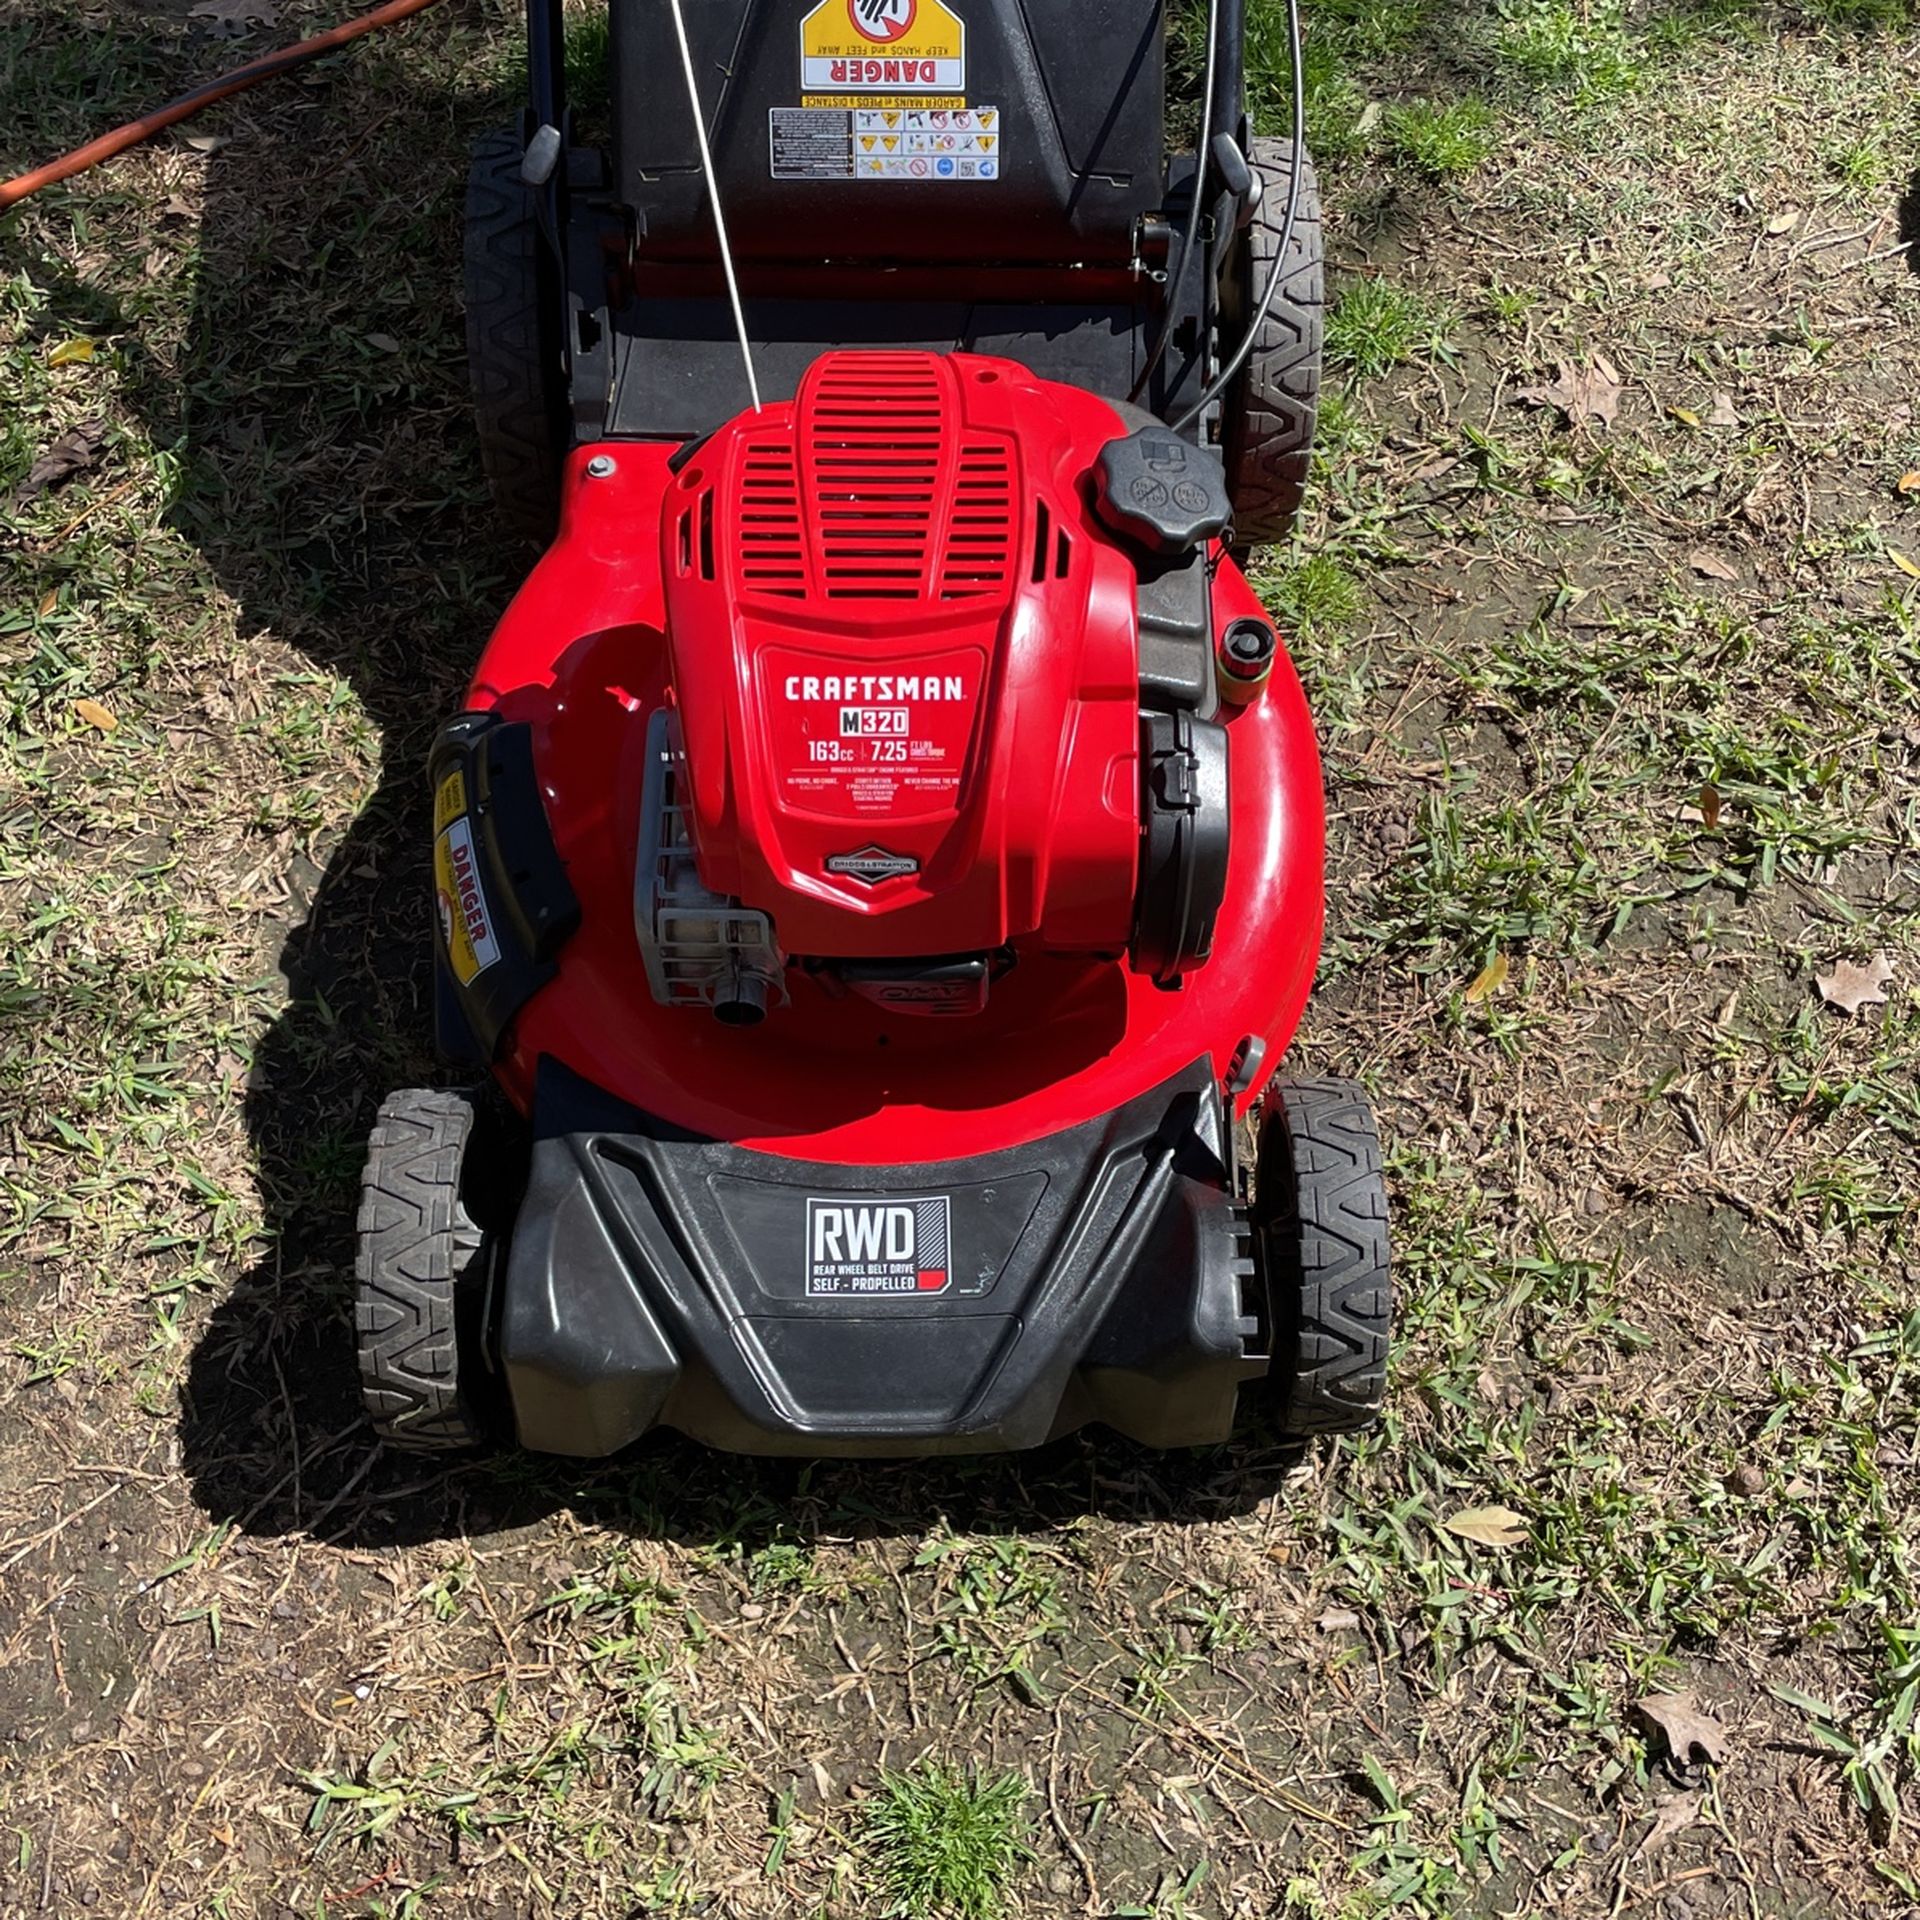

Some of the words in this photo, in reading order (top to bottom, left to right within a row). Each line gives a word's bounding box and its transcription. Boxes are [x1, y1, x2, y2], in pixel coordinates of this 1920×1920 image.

[817, 46, 840, 55] AWAY
[846, 46, 867, 55] FEET
[872, 45, 886, 55] and
[891, 46, 920, 55] HANDS
[926, 46, 948, 55] KEEP
[830, 60, 936, 83] DANGER
[805, 97, 848, 108] DISTANCE
[856, 97, 882, 108] PIEDS
[894, 97, 923, 108] MAINS
[925, 97, 962, 108] GARDER
[785, 676, 962, 700] CRAFTSMAN
[842, 711, 907, 733] M320
[808, 741, 854, 761] 163cc
[871, 741, 907, 761] 7.25
[452, 844, 487, 942] DANGER
[814, 1207, 914, 1261] RWD
[813, 1265, 836, 1275] REAR
[838, 1265, 865, 1275] WHEEL
[868, 1264, 887, 1275] BELT
[890, 1264, 914, 1274] DRIVE
[813, 1278, 841, 1291] SELF
[852, 1277, 915, 1291] PROPELLED
